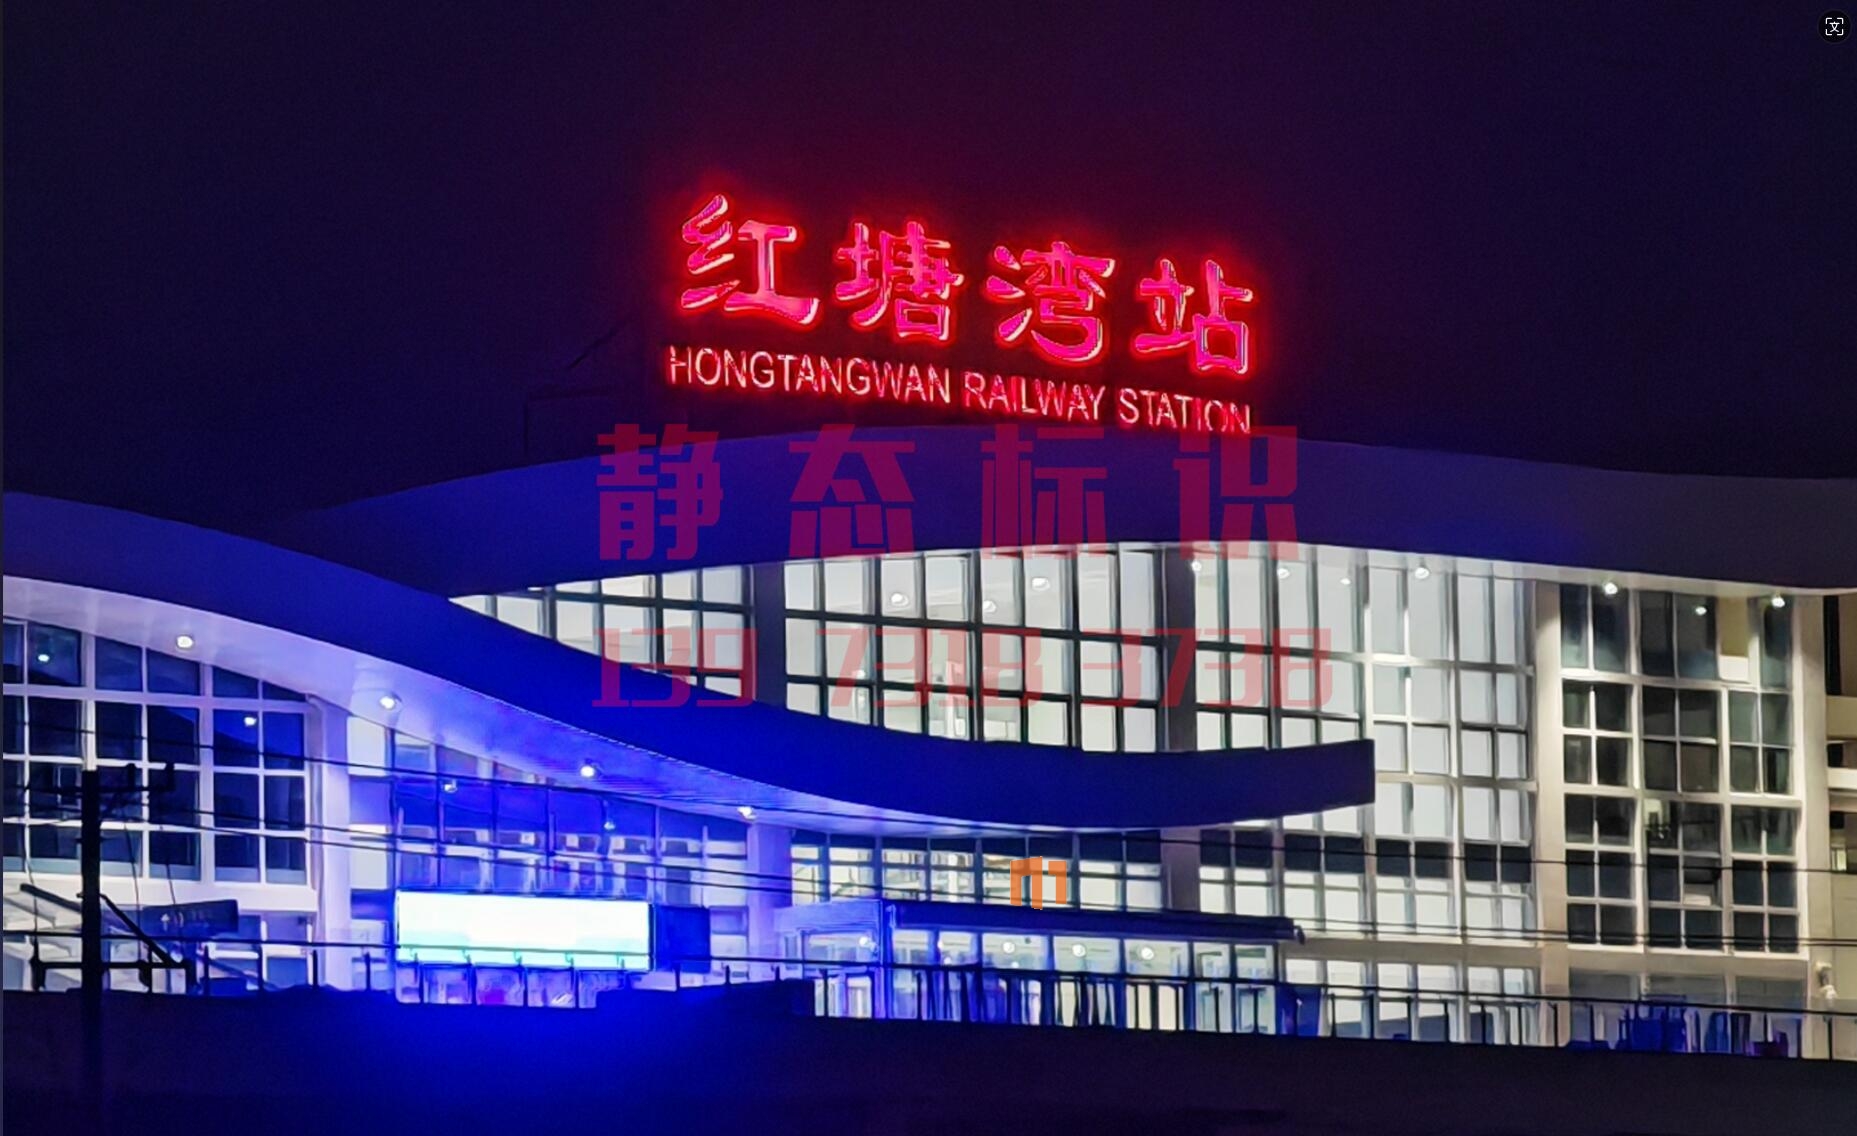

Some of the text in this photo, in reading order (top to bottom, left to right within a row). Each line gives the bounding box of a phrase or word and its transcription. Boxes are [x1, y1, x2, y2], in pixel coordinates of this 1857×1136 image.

[680, 195, 1254, 375] 红塘湾站
[668, 345, 1251, 434] HONGTANGWAN RAILWAY STATION
